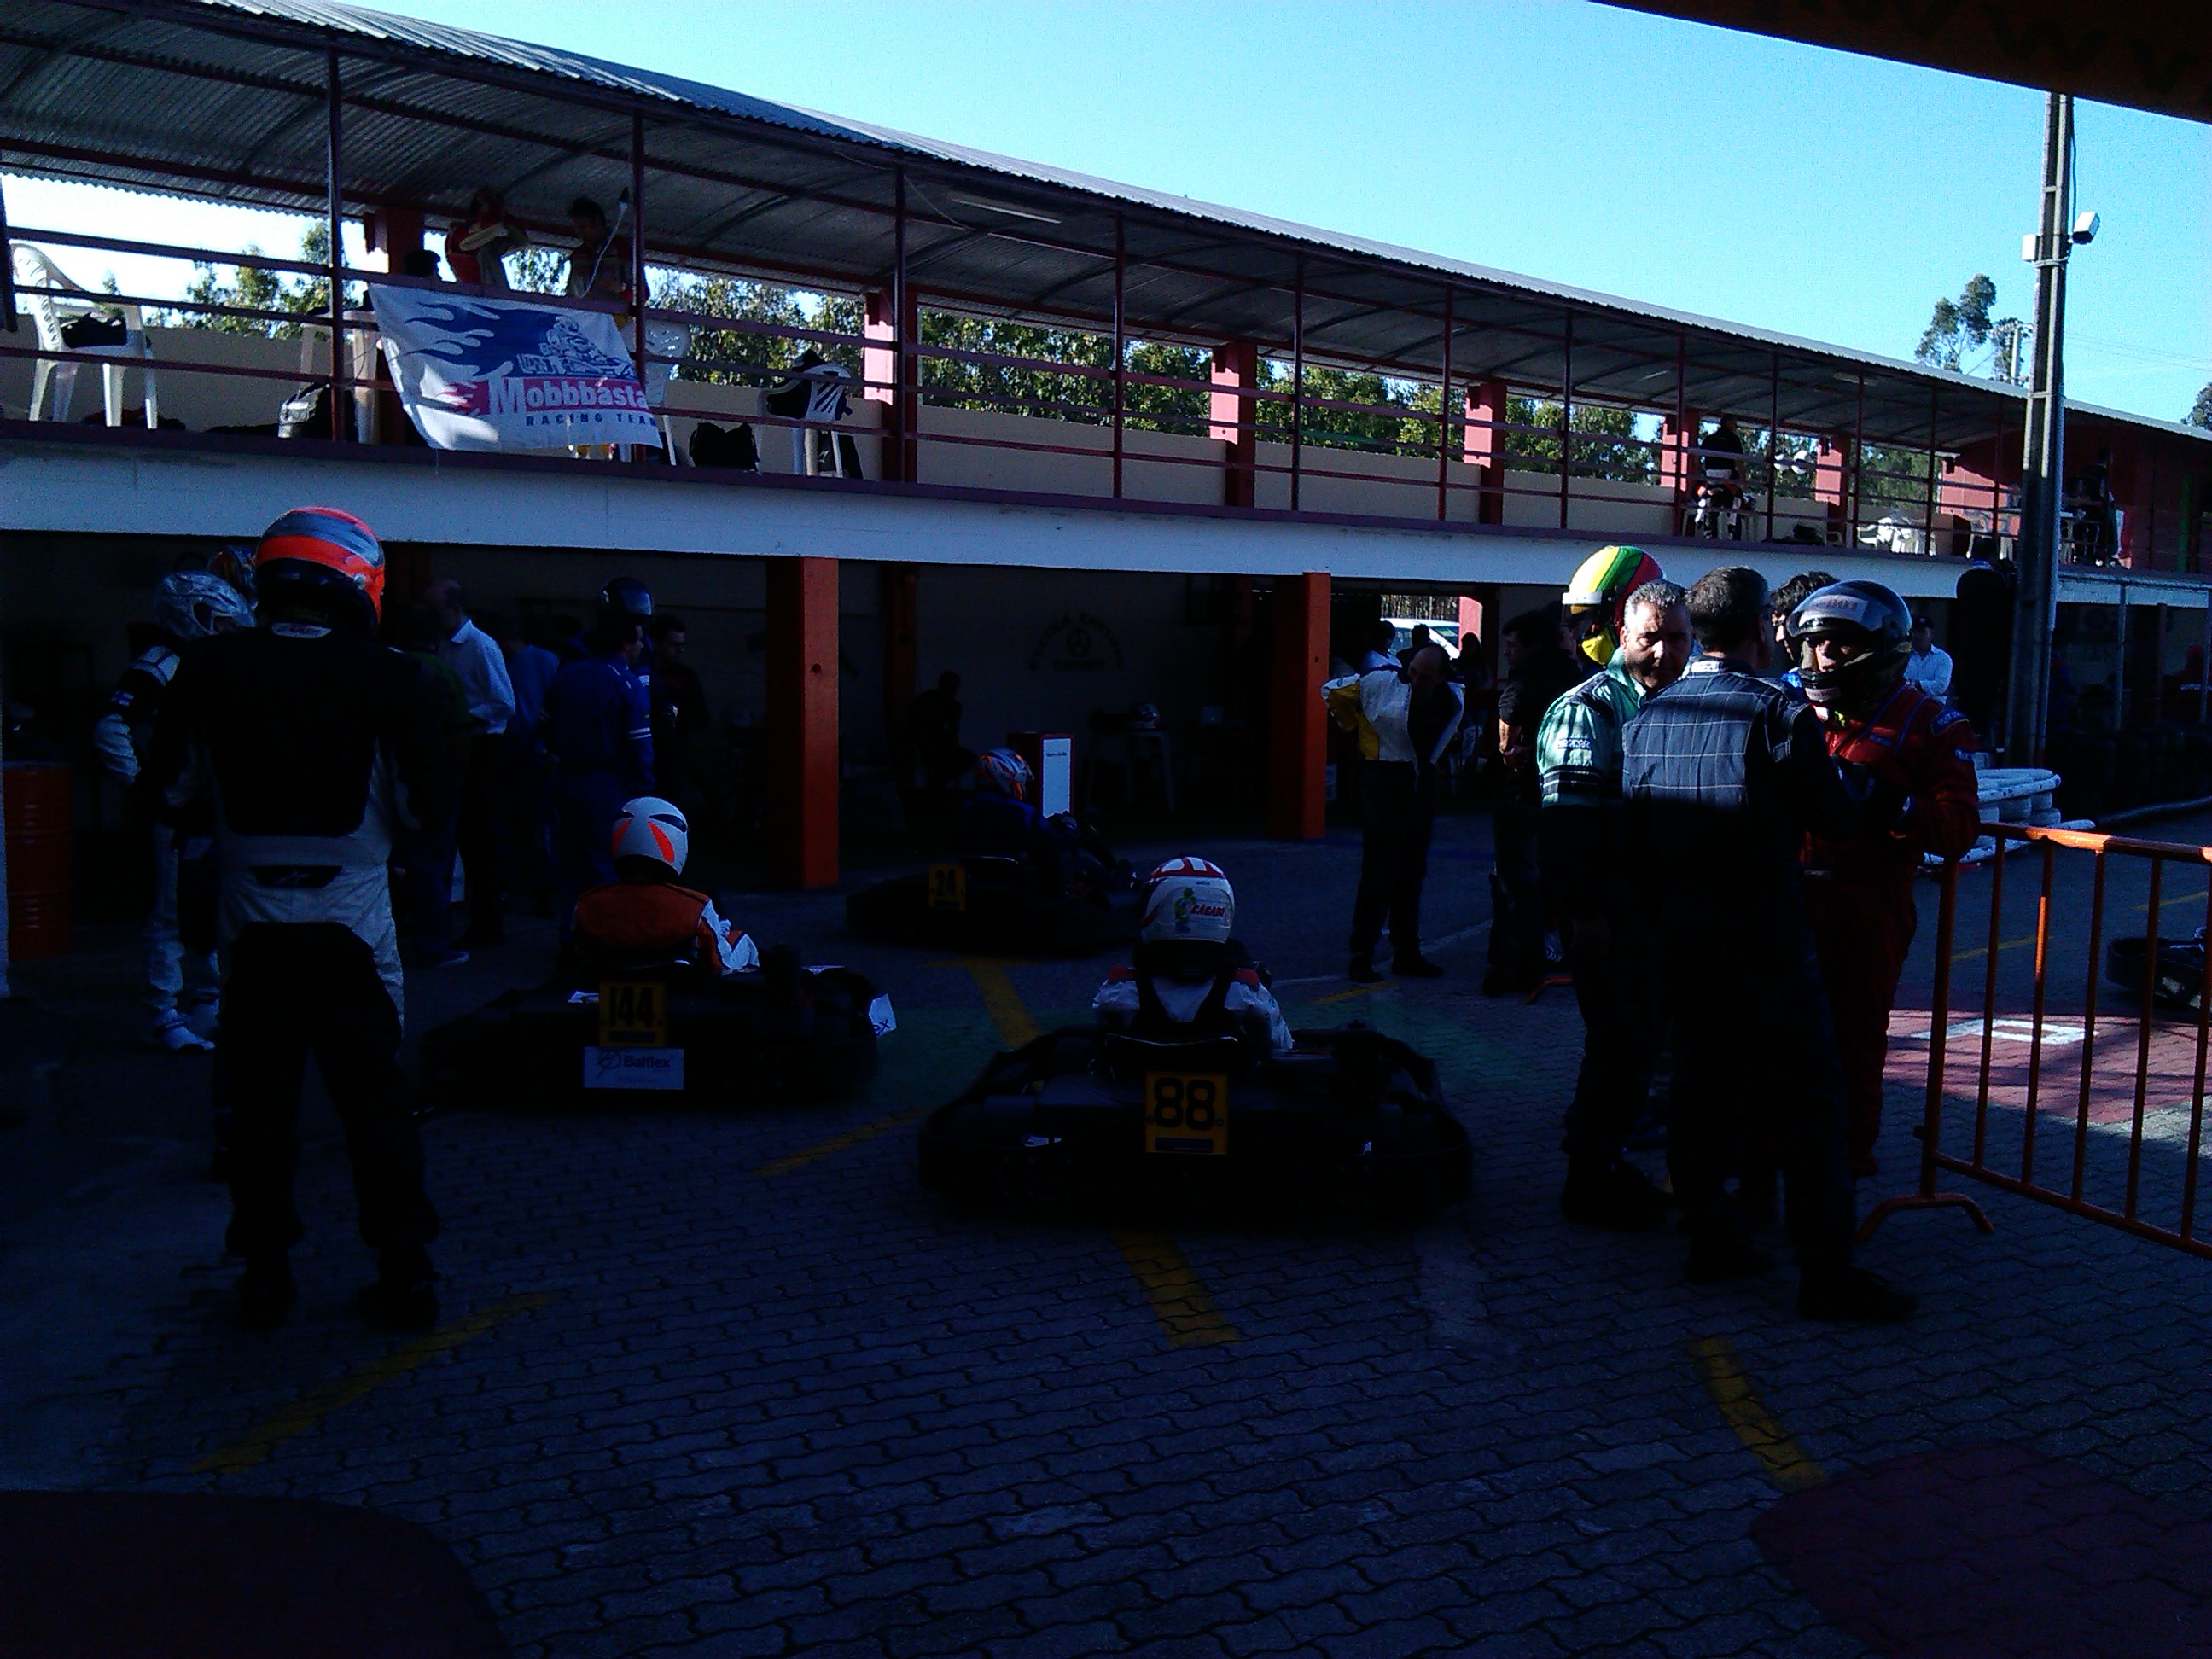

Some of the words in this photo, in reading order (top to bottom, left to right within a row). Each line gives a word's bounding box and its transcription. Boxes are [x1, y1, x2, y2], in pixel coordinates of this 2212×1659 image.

[526, 414, 602, 426] RACING
[936, 870, 956, 895] 24
[609, 985, 654, 1027] 144
[1154, 1077, 1216, 1131] 88
